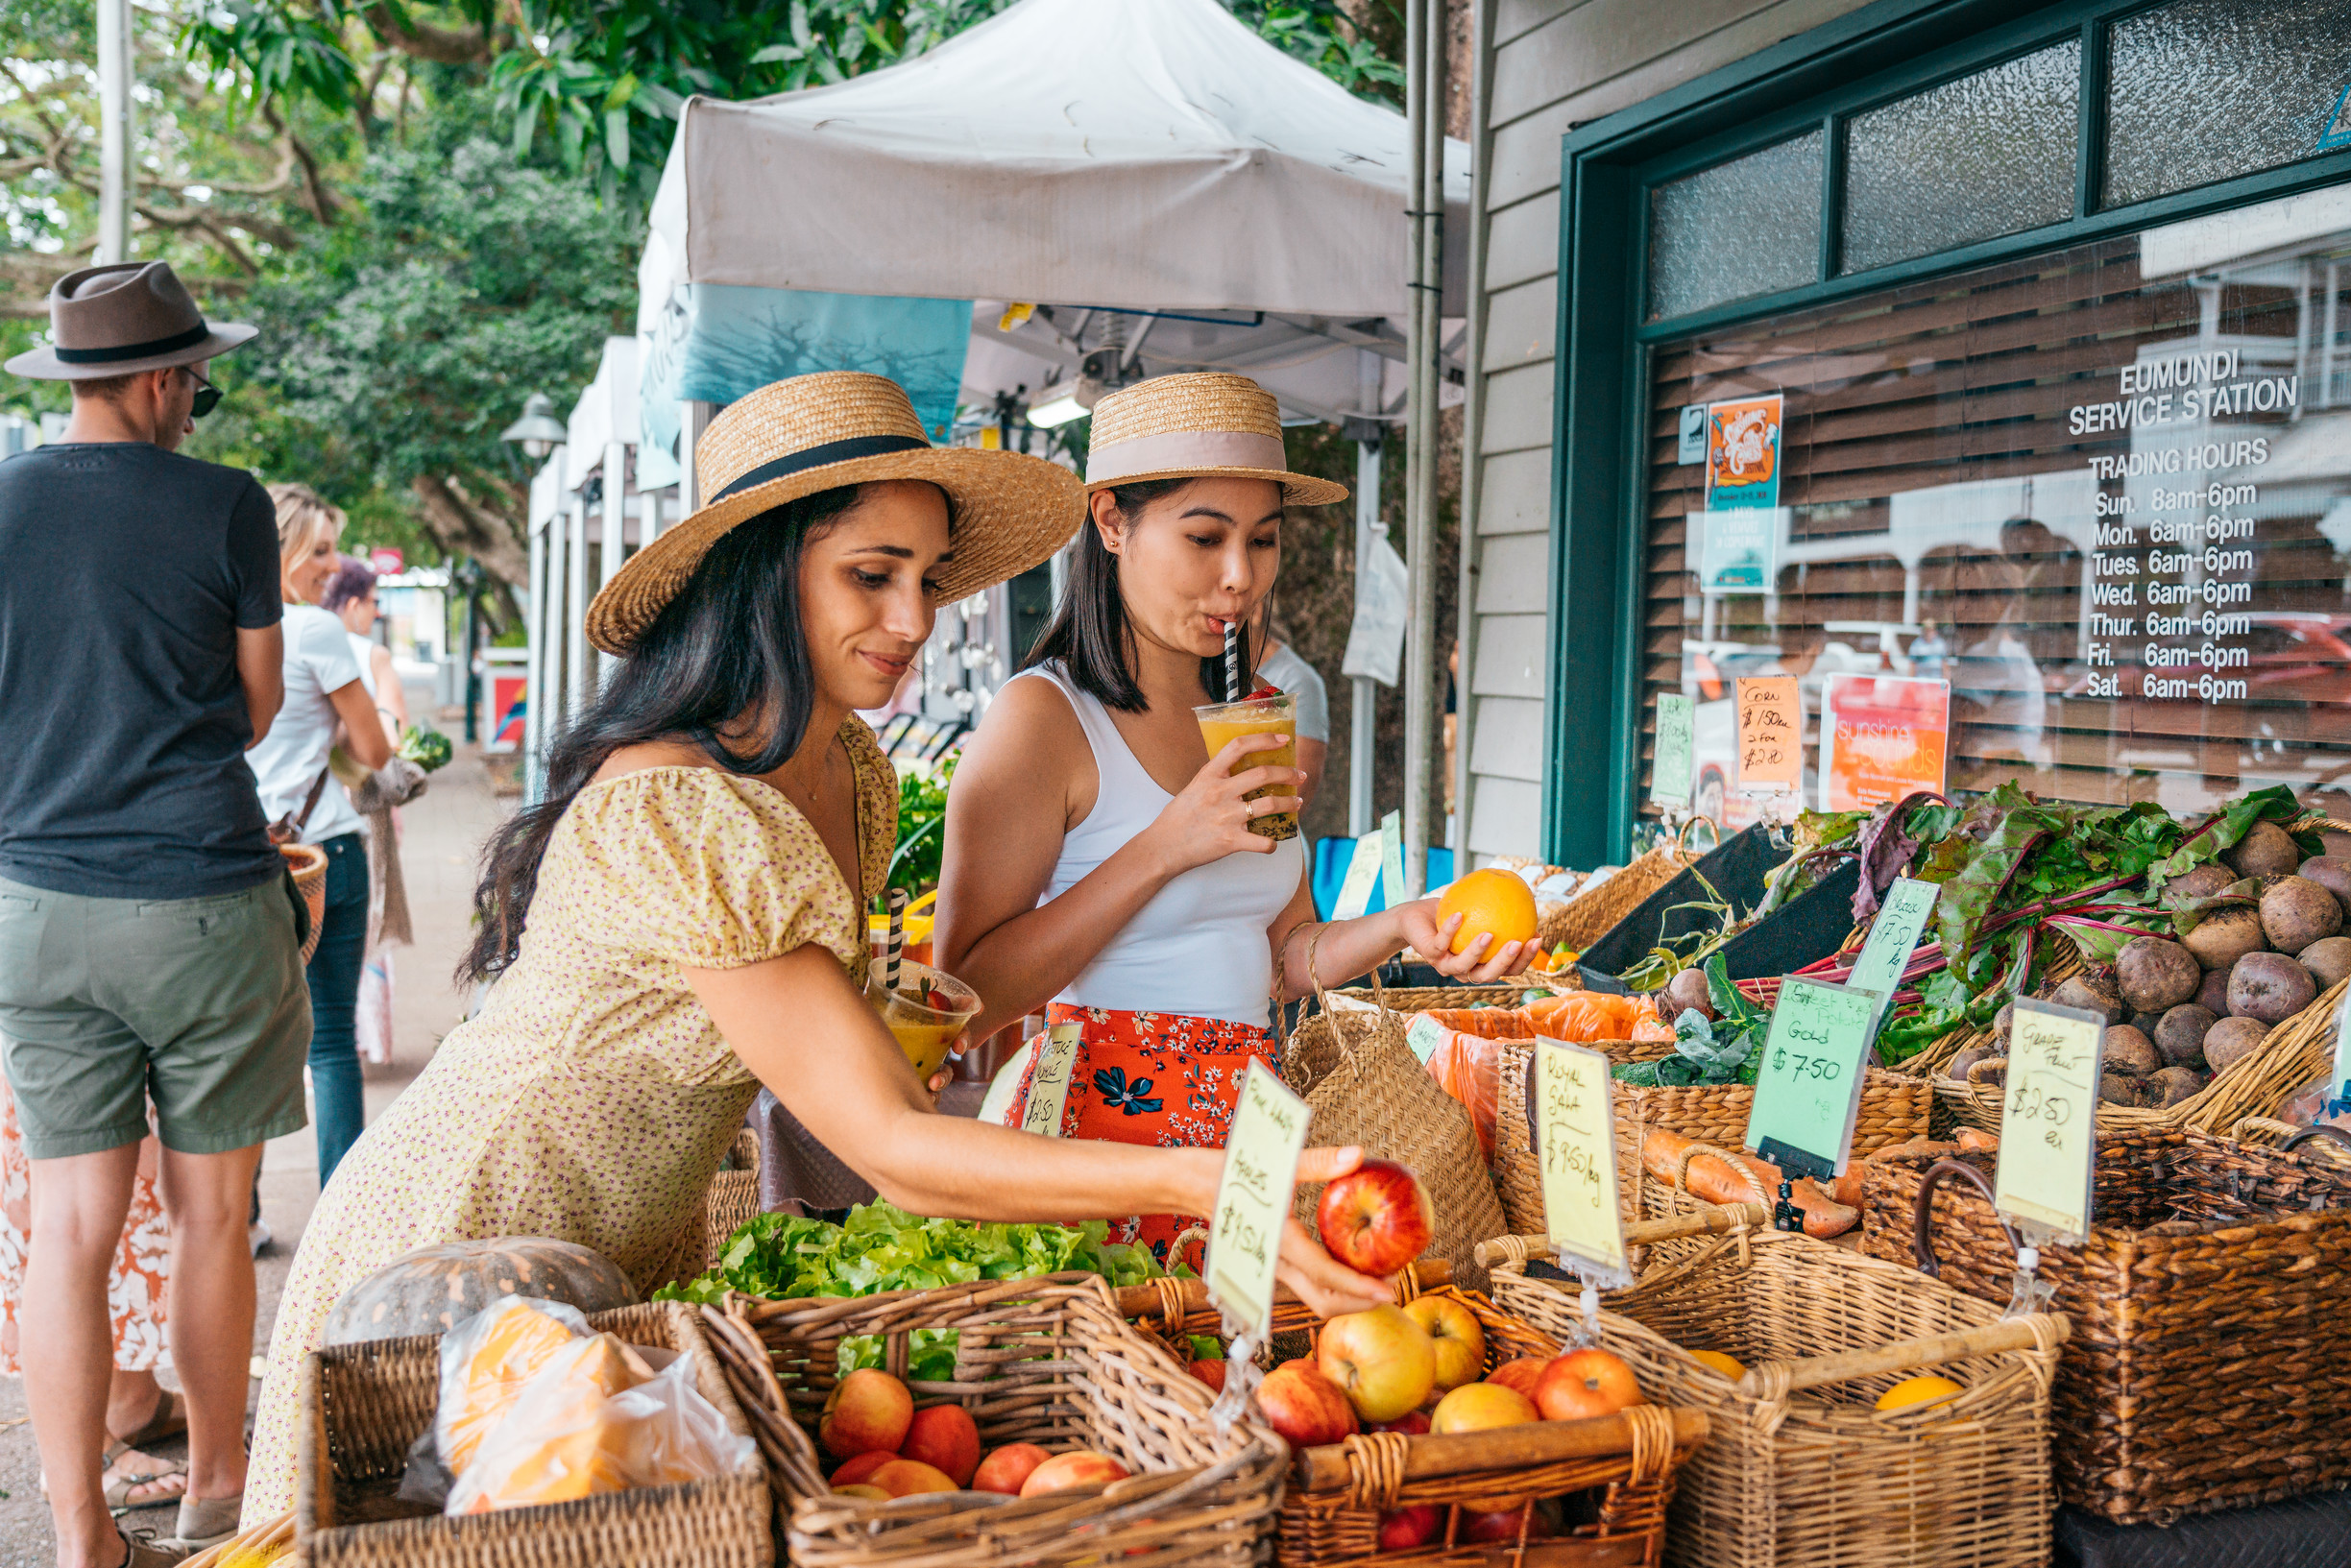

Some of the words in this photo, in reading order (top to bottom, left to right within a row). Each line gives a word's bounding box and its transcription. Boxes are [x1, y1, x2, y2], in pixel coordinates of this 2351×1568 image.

[2120, 349, 2239, 396] EUMUNDI
[2069, 393, 2174, 436] SERVICE
[2181, 375, 2298, 421] STATION
[2088, 448, 2181, 480] TRADING
[2187, 437, 2268, 470] HOURS
[2094, 492, 2136, 517] Sun.
[2092, 522, 2138, 546] Mon.
[2092, 552, 2141, 577] Tues.
[2091, 581, 2138, 606] Wed.
[2089, 613, 2138, 637] Thur.
[2087, 642, 2115, 666] Fri.
[2087, 671, 2122, 697] Sat.
[1837, 717, 1909, 747] sunshine
[1858, 739, 1937, 777] sounds
